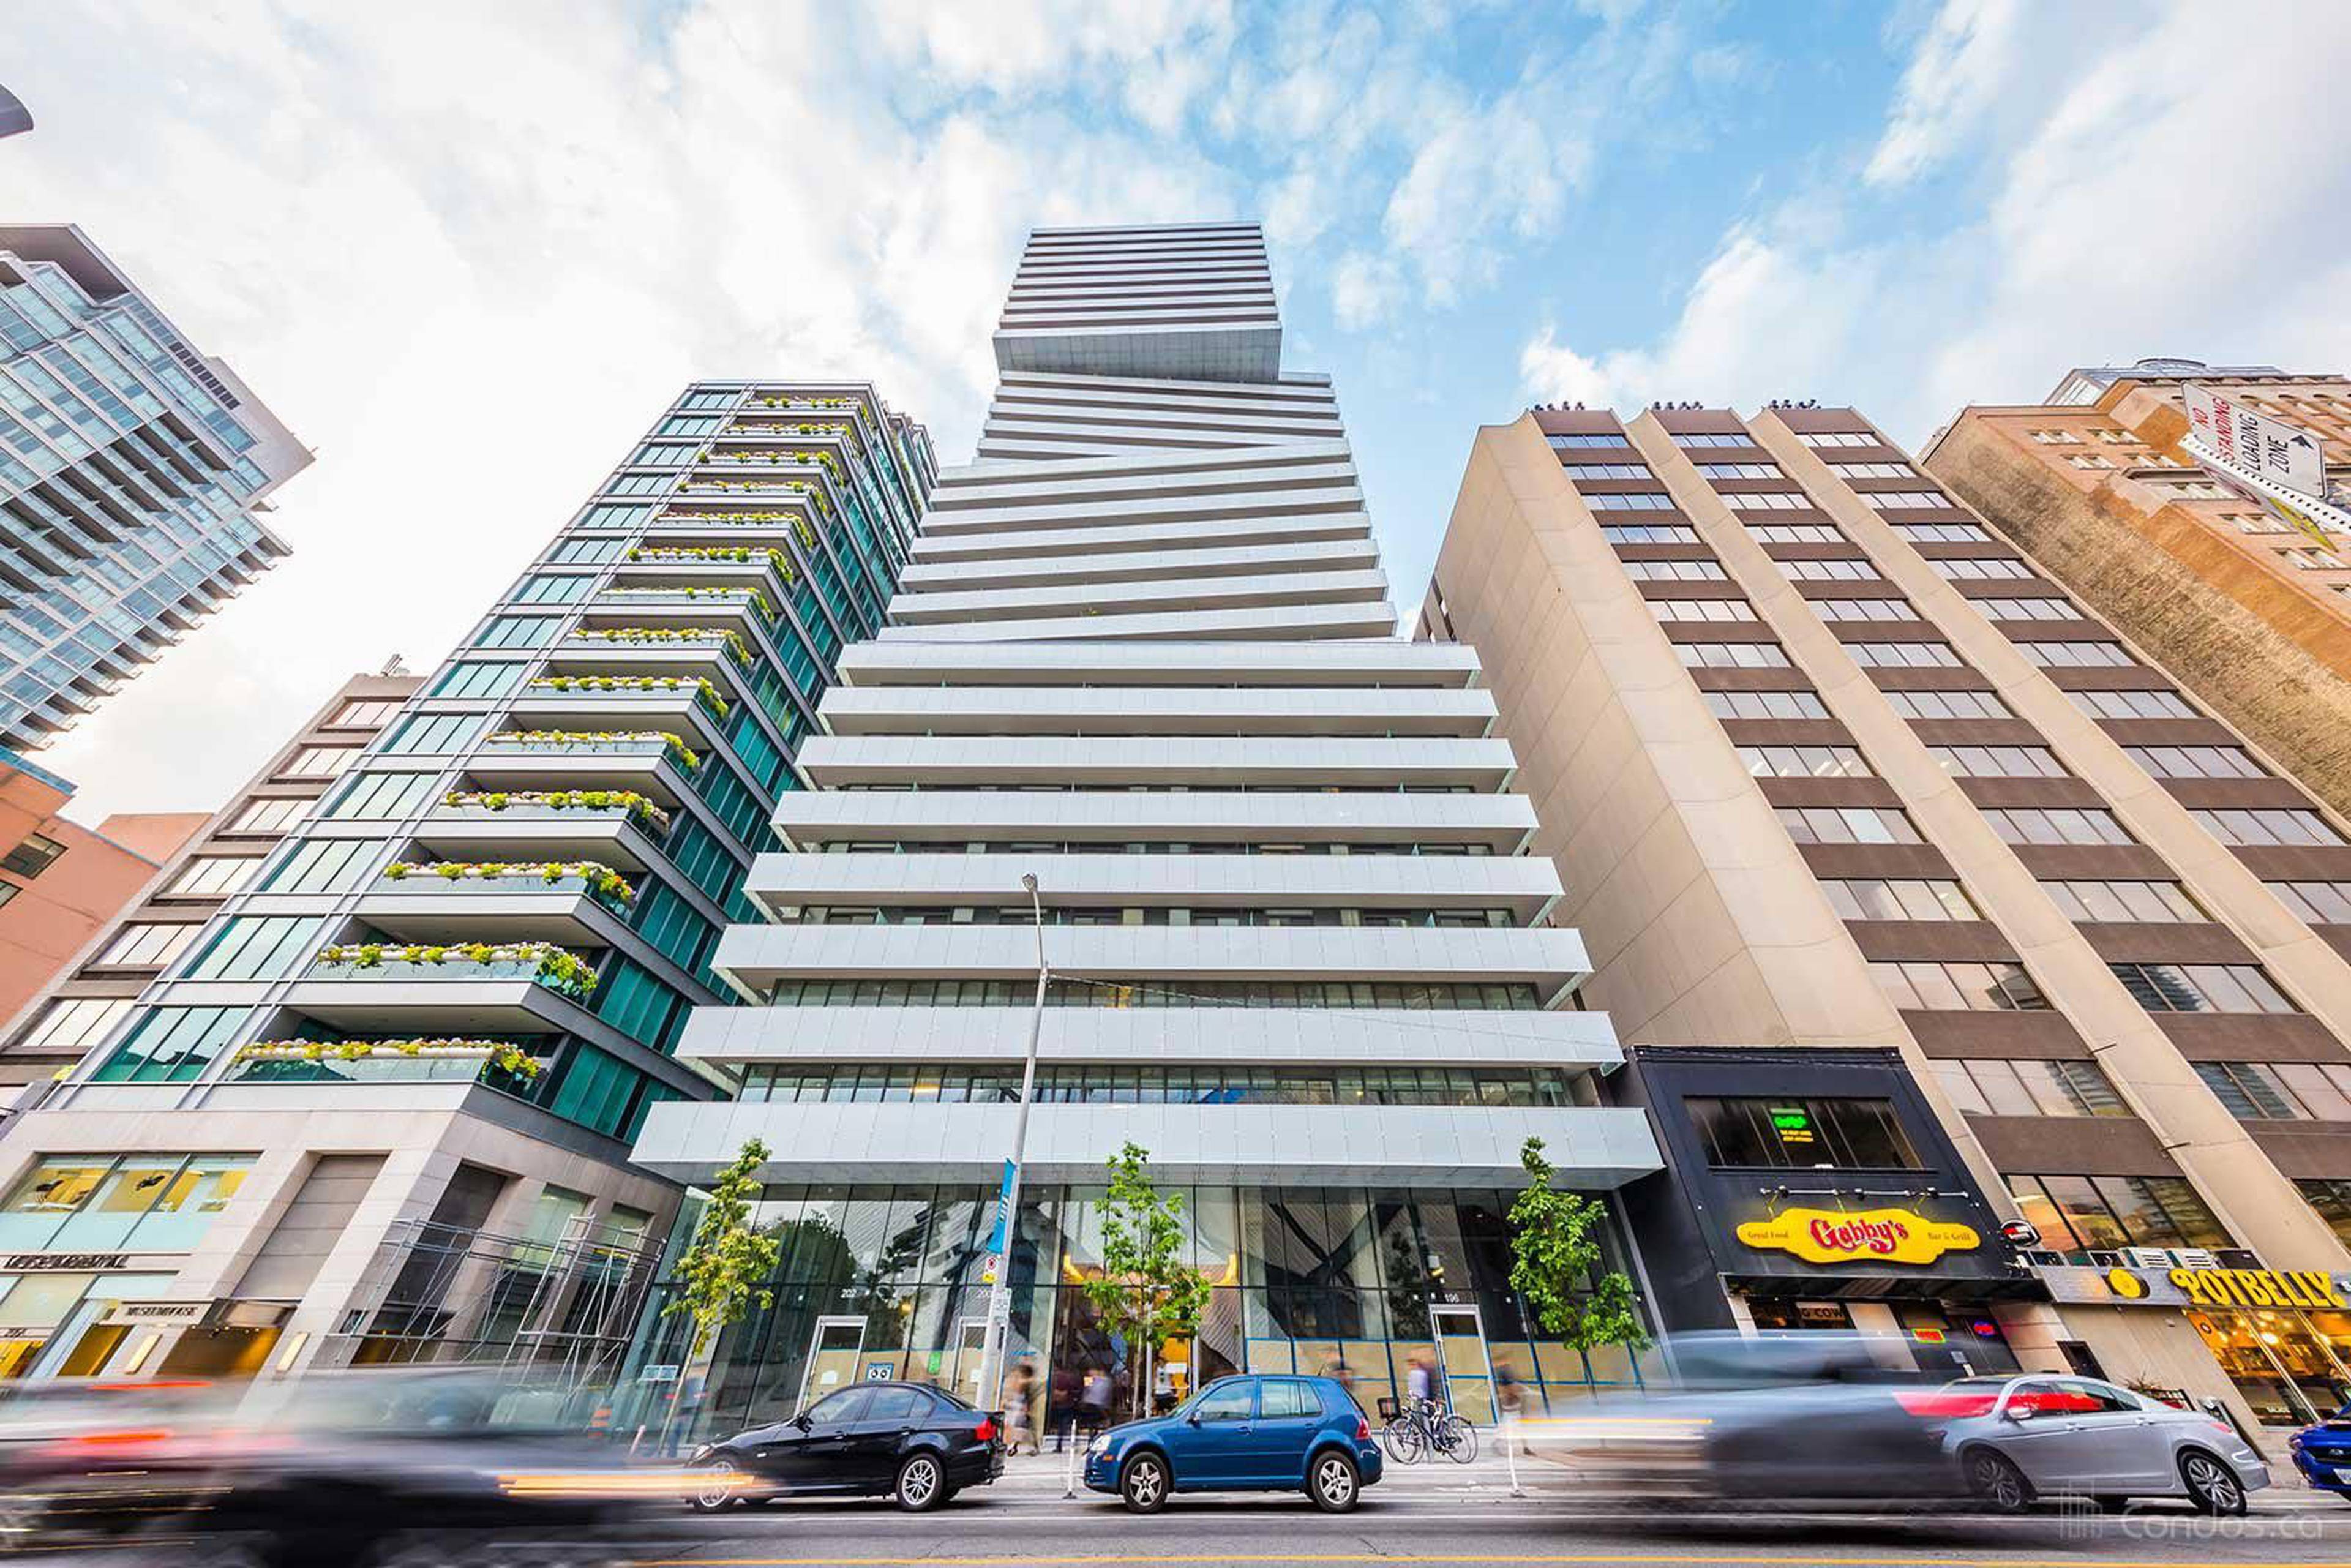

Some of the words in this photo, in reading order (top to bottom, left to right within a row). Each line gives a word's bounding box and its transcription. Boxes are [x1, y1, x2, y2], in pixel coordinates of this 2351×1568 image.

[2192, 407, 2209, 427] NO
[2213, 398, 2235, 460] STANDING
[2239, 413, 2260, 471] LOADING
[2267, 435, 2290, 474] ZONE
[1810, 1218, 1908, 1254] Gabby's
[2169, 1268, 2347, 1308] POTBELLY
